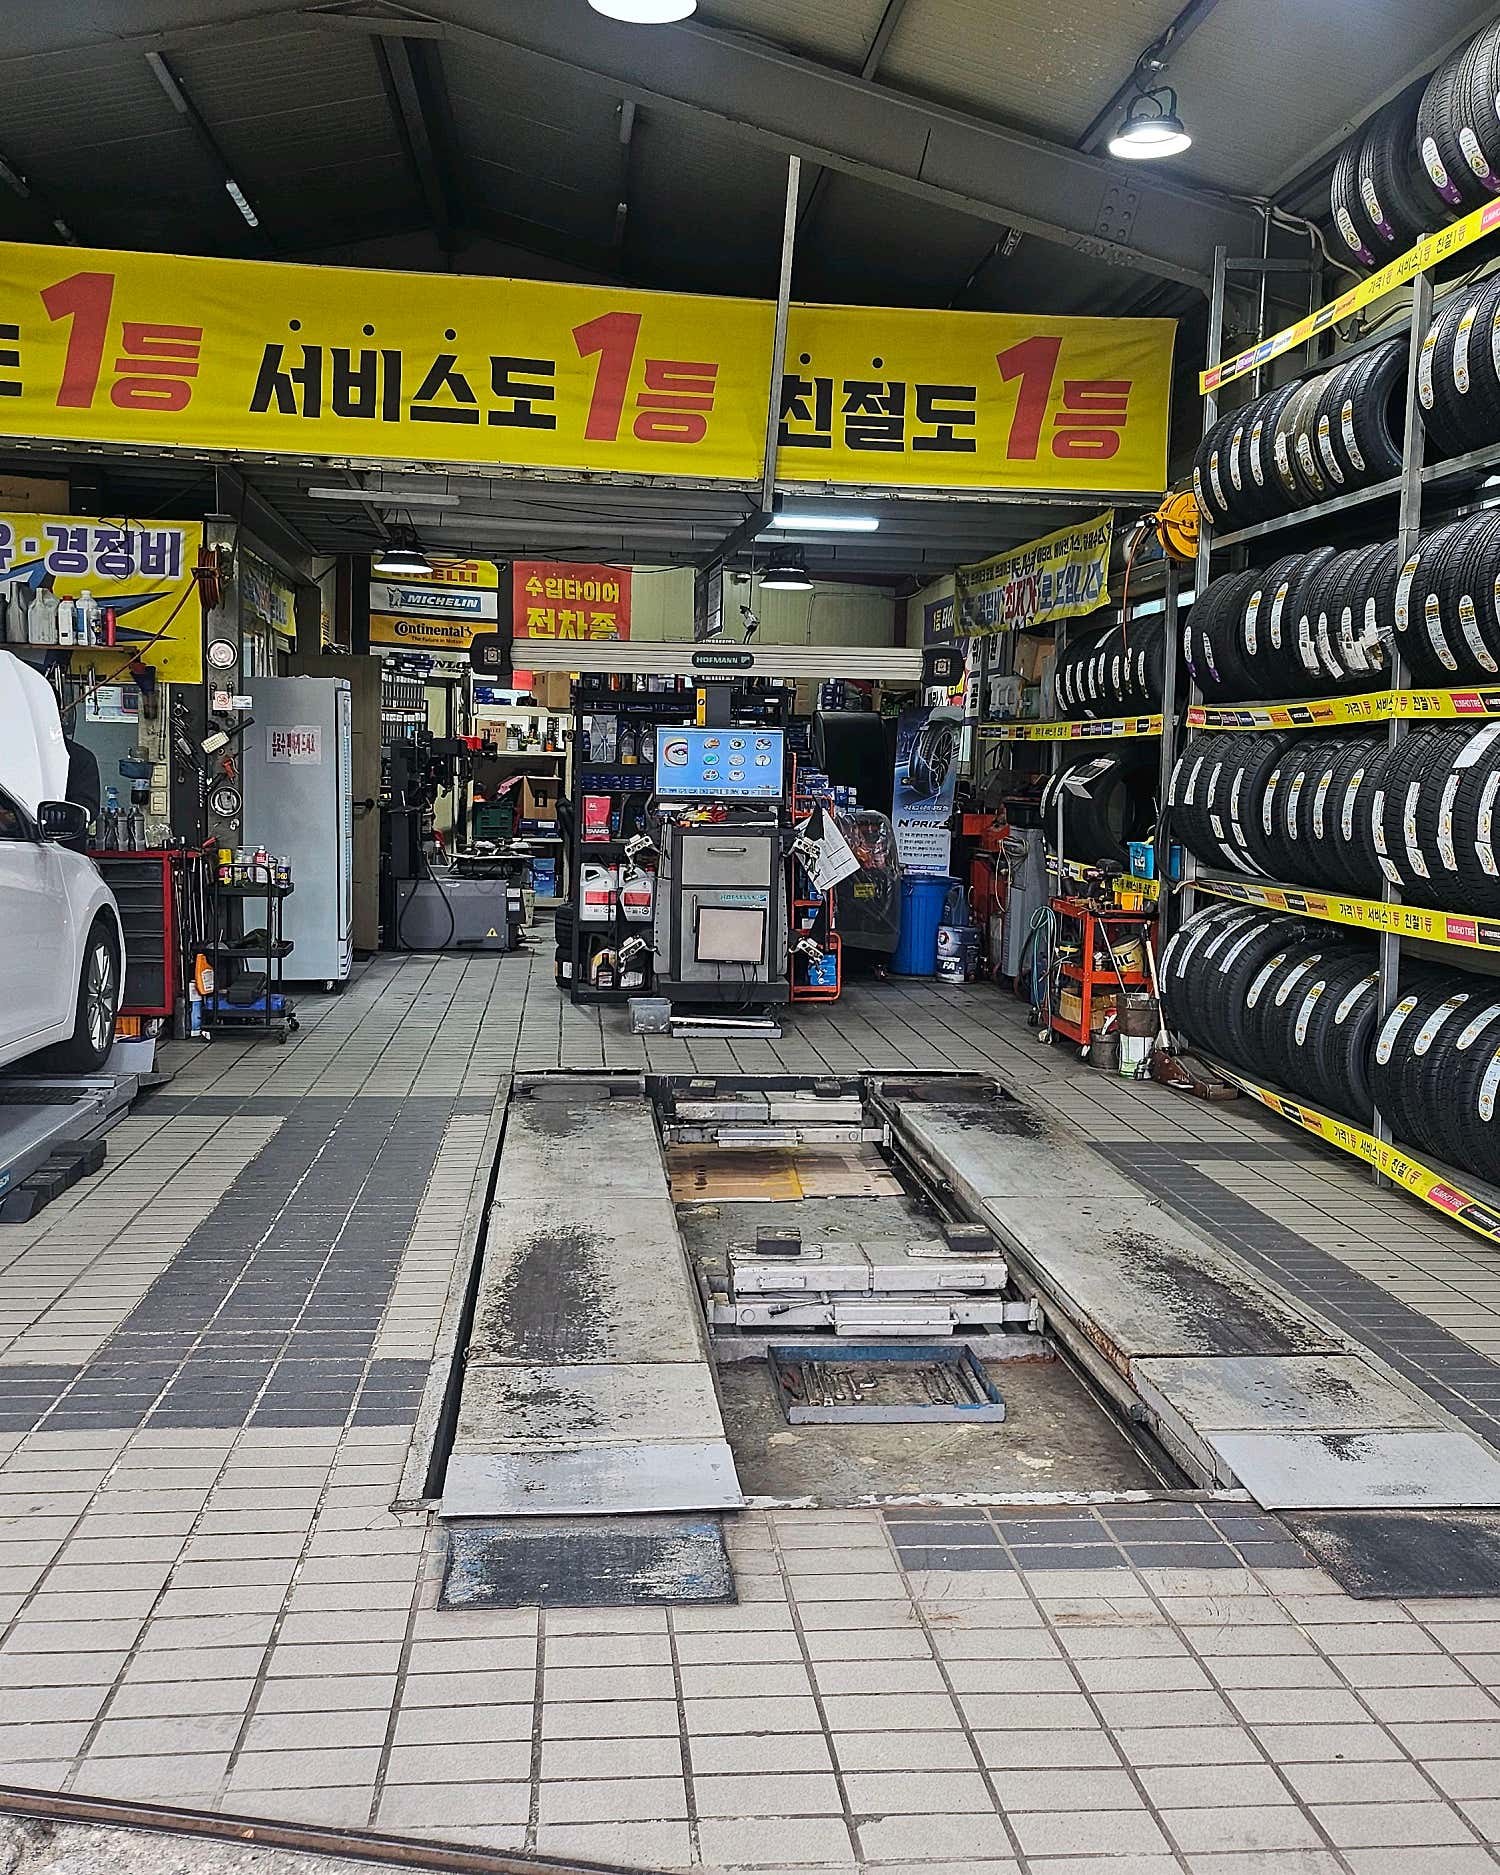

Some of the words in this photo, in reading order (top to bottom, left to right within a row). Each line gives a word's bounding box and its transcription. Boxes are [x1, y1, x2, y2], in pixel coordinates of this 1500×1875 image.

[1436, 224, 1466, 254] 친절1등
[407, 594, 479, 609] MICHELIN
[525, 576, 620, 603] 수입타이어
[394, 620, 464, 638] Continental
[526, 607, 618, 641] 전차종
[696, 656, 738, 664] HOFMANN
[1344, 700, 1371, 716] 가격1등
[1375, 695, 1408, 712] 서비스1등
[1412, 694, 1441, 712] 친절1등
[1339, 903, 1363, 920] 가격1등
[1367, 908, 1400, 927] 서비스1등
[1404, 913, 1432, 933] 친절1등
[1333, 1126, 1357, 1149] 가격1등
[1360, 1139, 1389, 1167] 서비스1등
[1391, 1157, 1422, 1185] 친절1등
